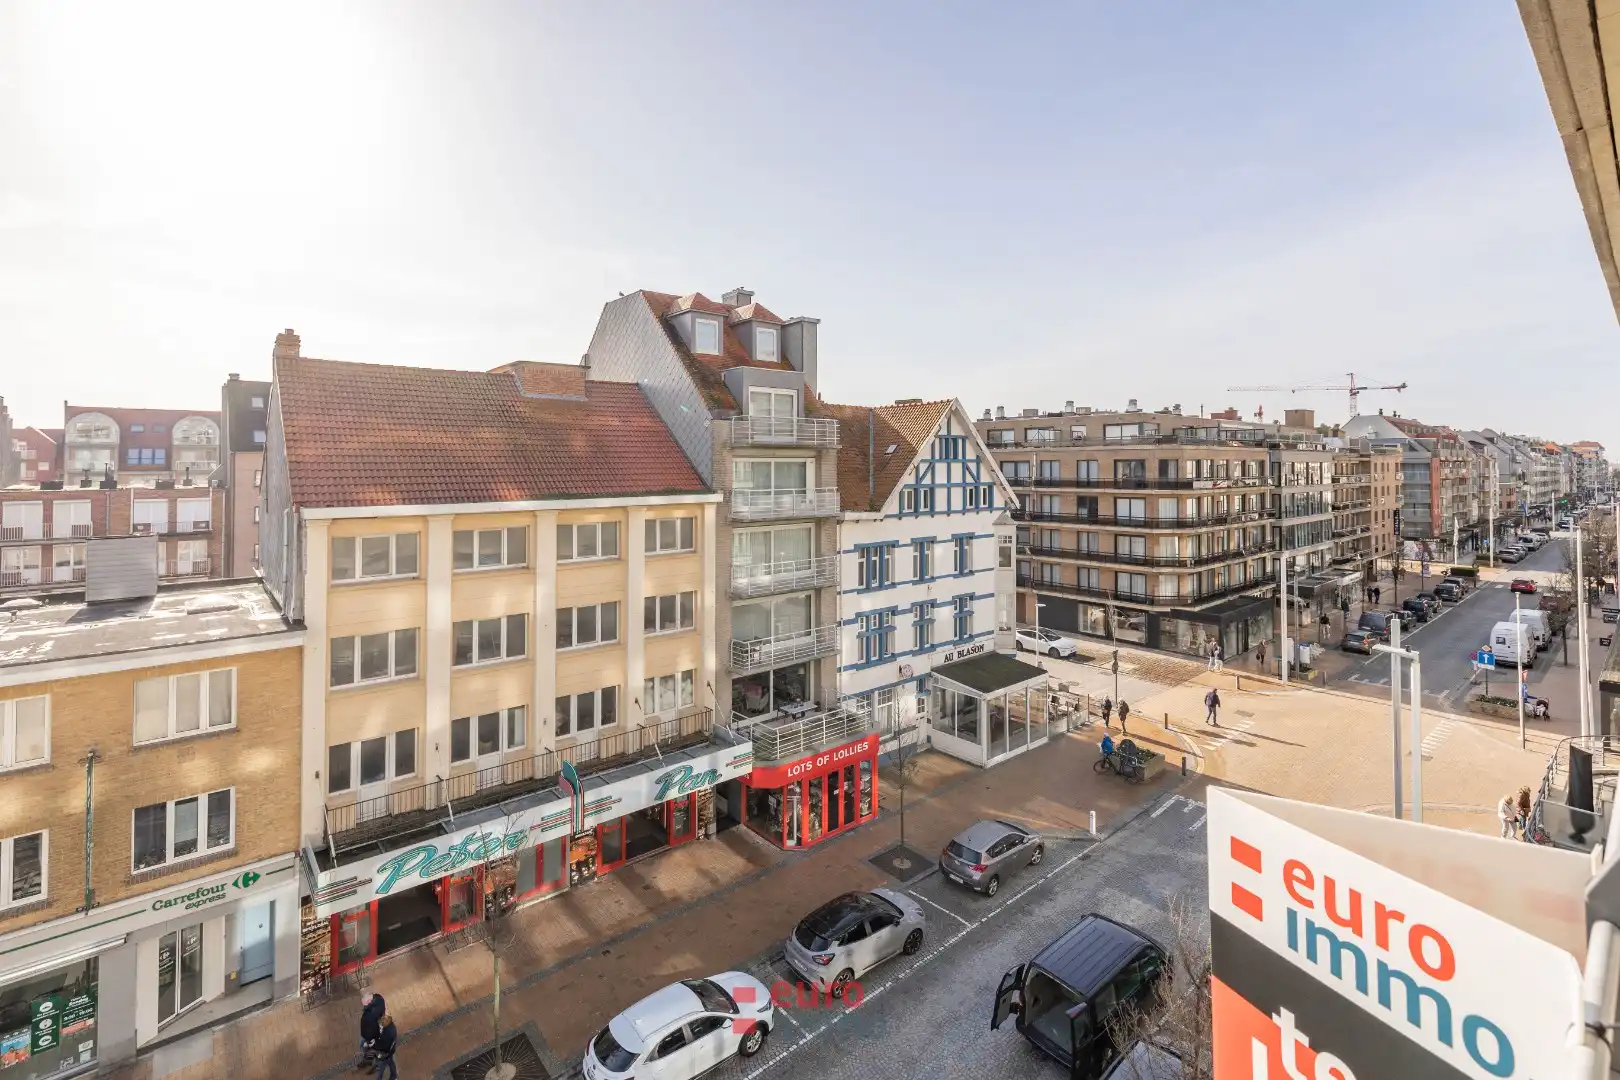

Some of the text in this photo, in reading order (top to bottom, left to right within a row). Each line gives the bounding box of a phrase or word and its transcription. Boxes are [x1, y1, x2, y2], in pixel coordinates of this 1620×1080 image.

[943, 643, 986, 664] AU BLASON
[786, 741, 869, 778] LOTS OF LOLLIES
[654, 764, 722, 801] Pan
[375, 829, 528, 895] Peter
[151, 882, 228, 912] Carrefour
[184, 892, 227, 911] express
[1282, 859, 1456, 982] euro
[1286, 906, 1515, 1079] immo
